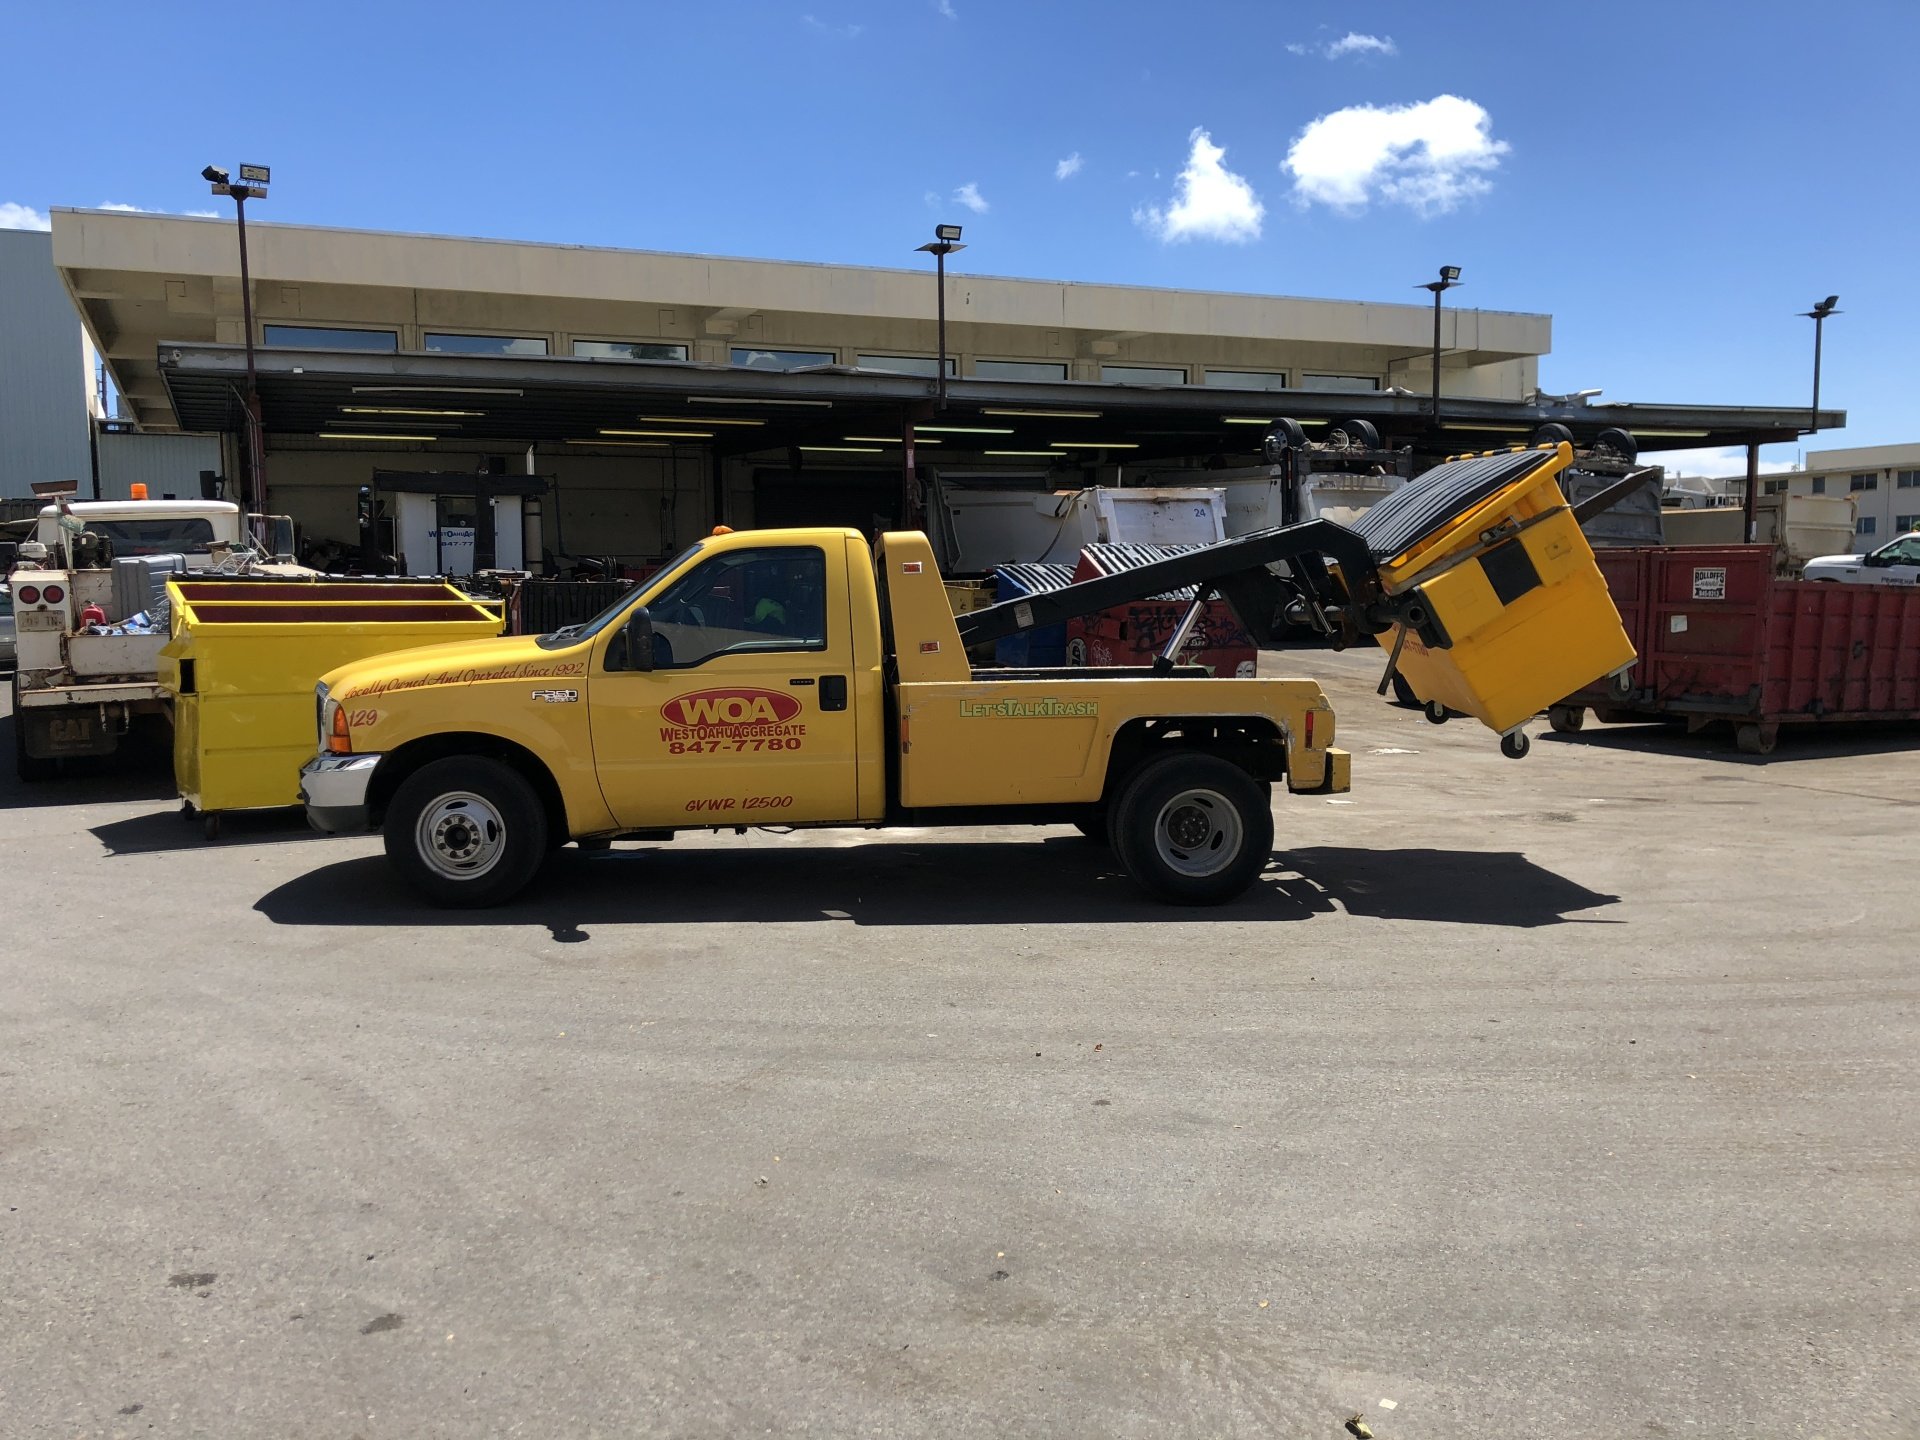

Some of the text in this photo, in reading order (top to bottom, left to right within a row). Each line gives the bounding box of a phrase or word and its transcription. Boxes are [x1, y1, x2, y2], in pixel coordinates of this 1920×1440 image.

[1193, 508, 1206, 517] 24
[1695, 571, 1724, 584] ROLLOFFS
[343, 662, 584, 701] Locally Owned And Operated Since 1992
[349, 709, 377, 727] 129
[678, 697, 780, 725] WOA
[49, 718, 90, 741] CAT
[669, 737, 802, 754] 847-7780
[685, 795, 793, 812] GVWR 12500
